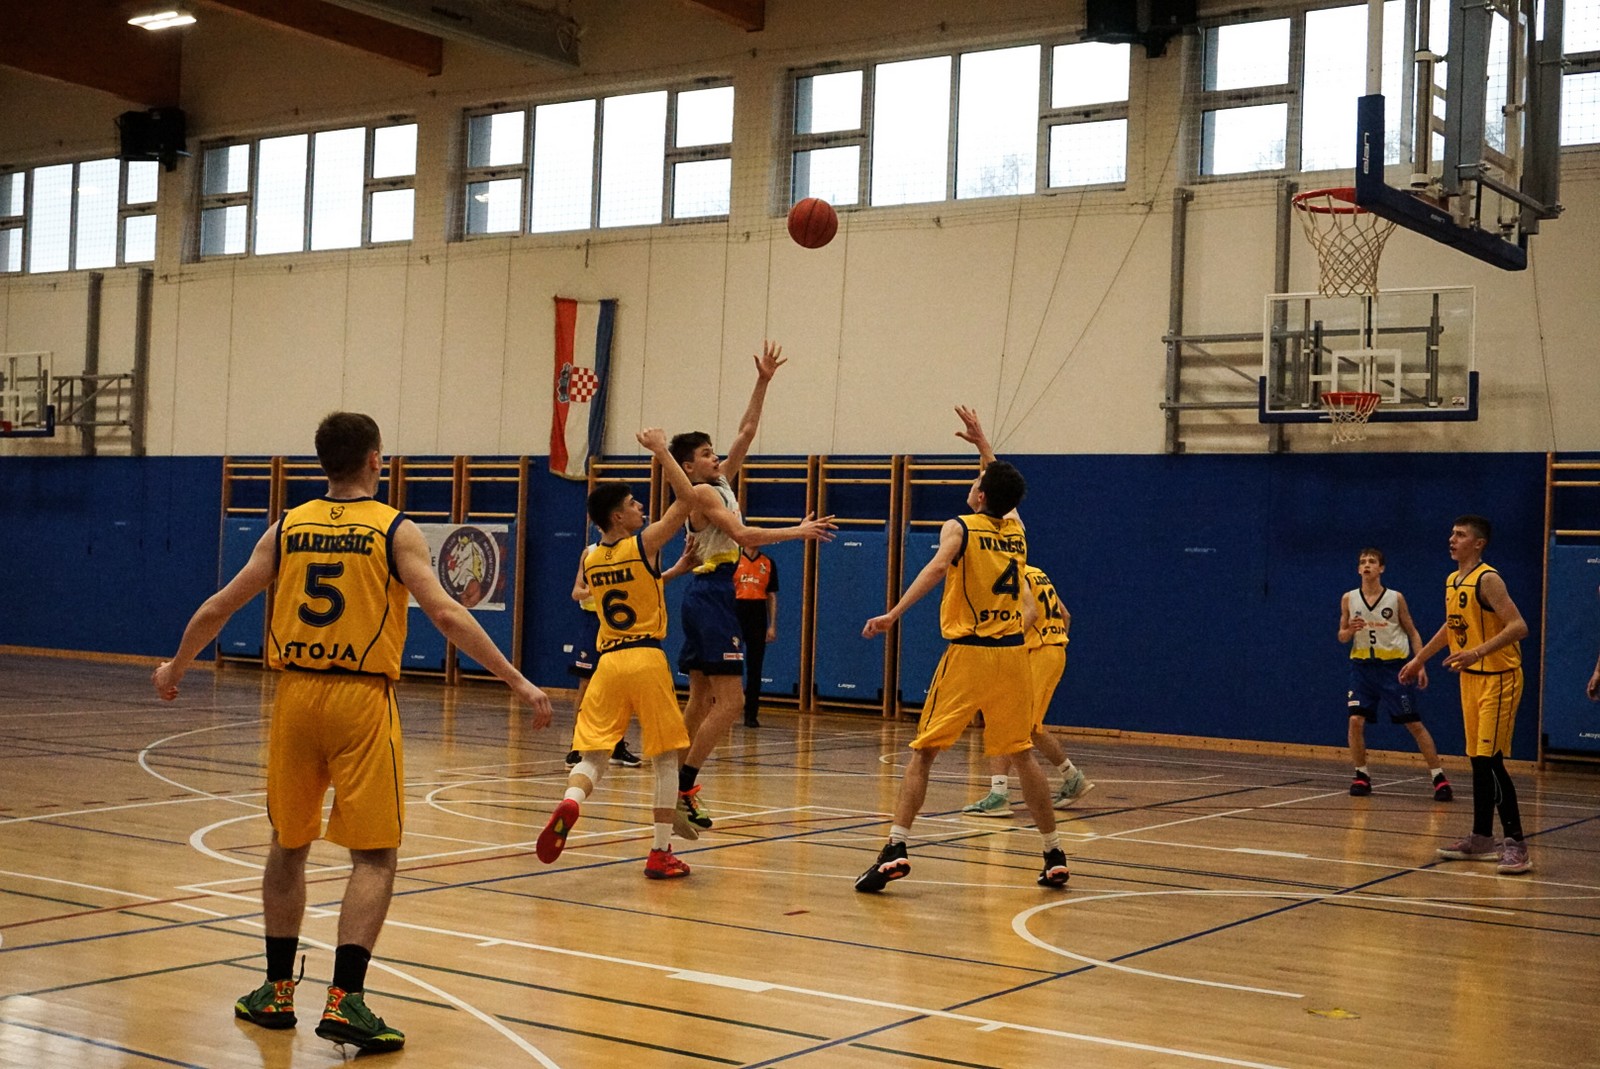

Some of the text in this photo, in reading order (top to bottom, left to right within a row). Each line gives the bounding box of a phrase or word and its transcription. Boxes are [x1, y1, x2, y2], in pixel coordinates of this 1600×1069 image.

[591, 568, 635, 587] CETINA
[992, 558, 1019, 601] 4
[298, 561, 345, 627] 5
[1037, 588, 1061, 621] 12
[1459, 591, 1468, 609] 9
[602, 589, 637, 631] 6
[1369, 630, 1377, 644] 5
[283, 640, 358, 663] STOJA
